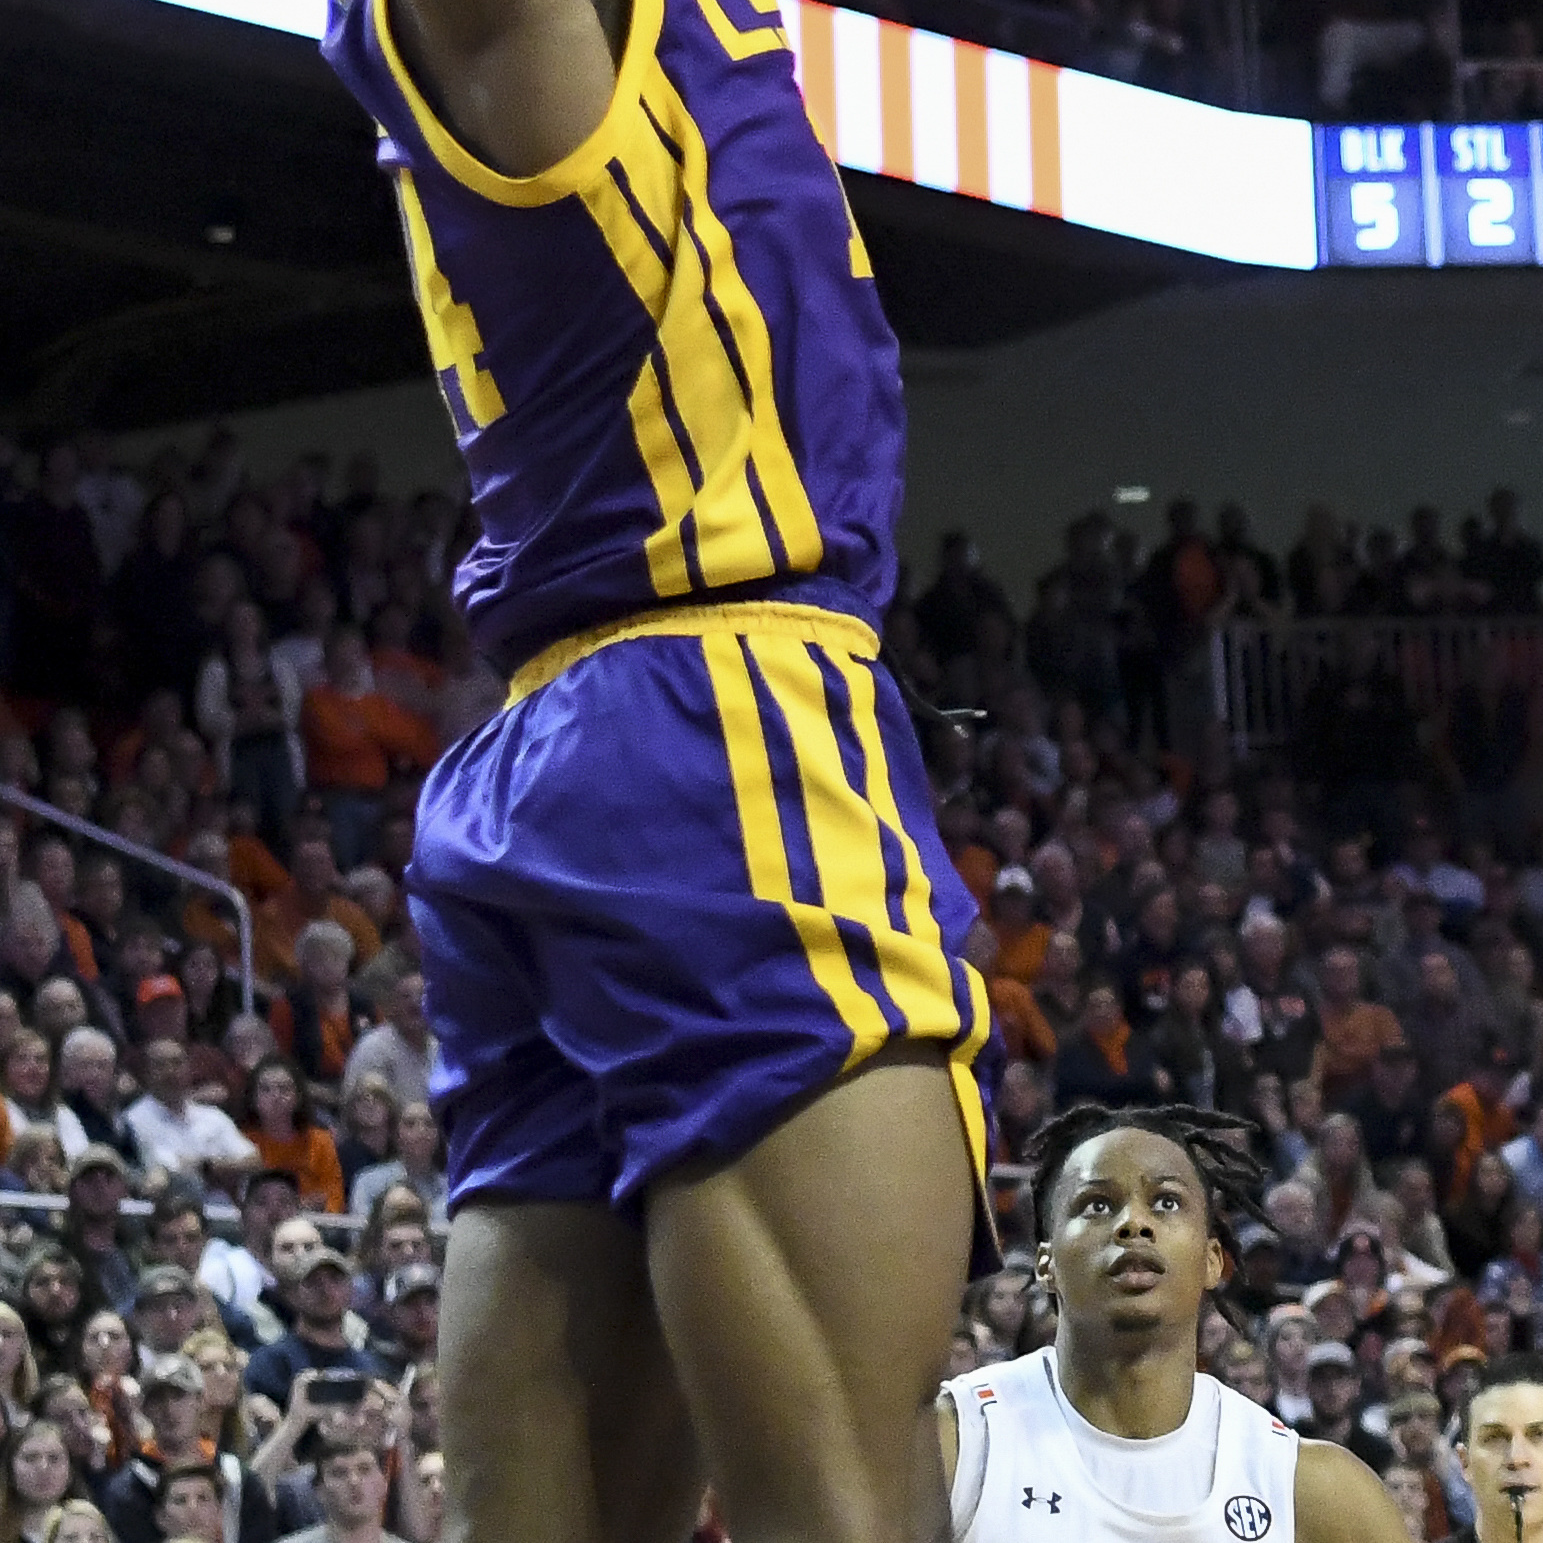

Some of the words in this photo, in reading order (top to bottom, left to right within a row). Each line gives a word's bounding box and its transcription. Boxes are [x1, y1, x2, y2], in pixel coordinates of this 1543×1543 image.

[1349, 182, 1400, 251] 5
[1466, 178, 1516, 247] 2
[1226, 1497, 1270, 1540] SEC
